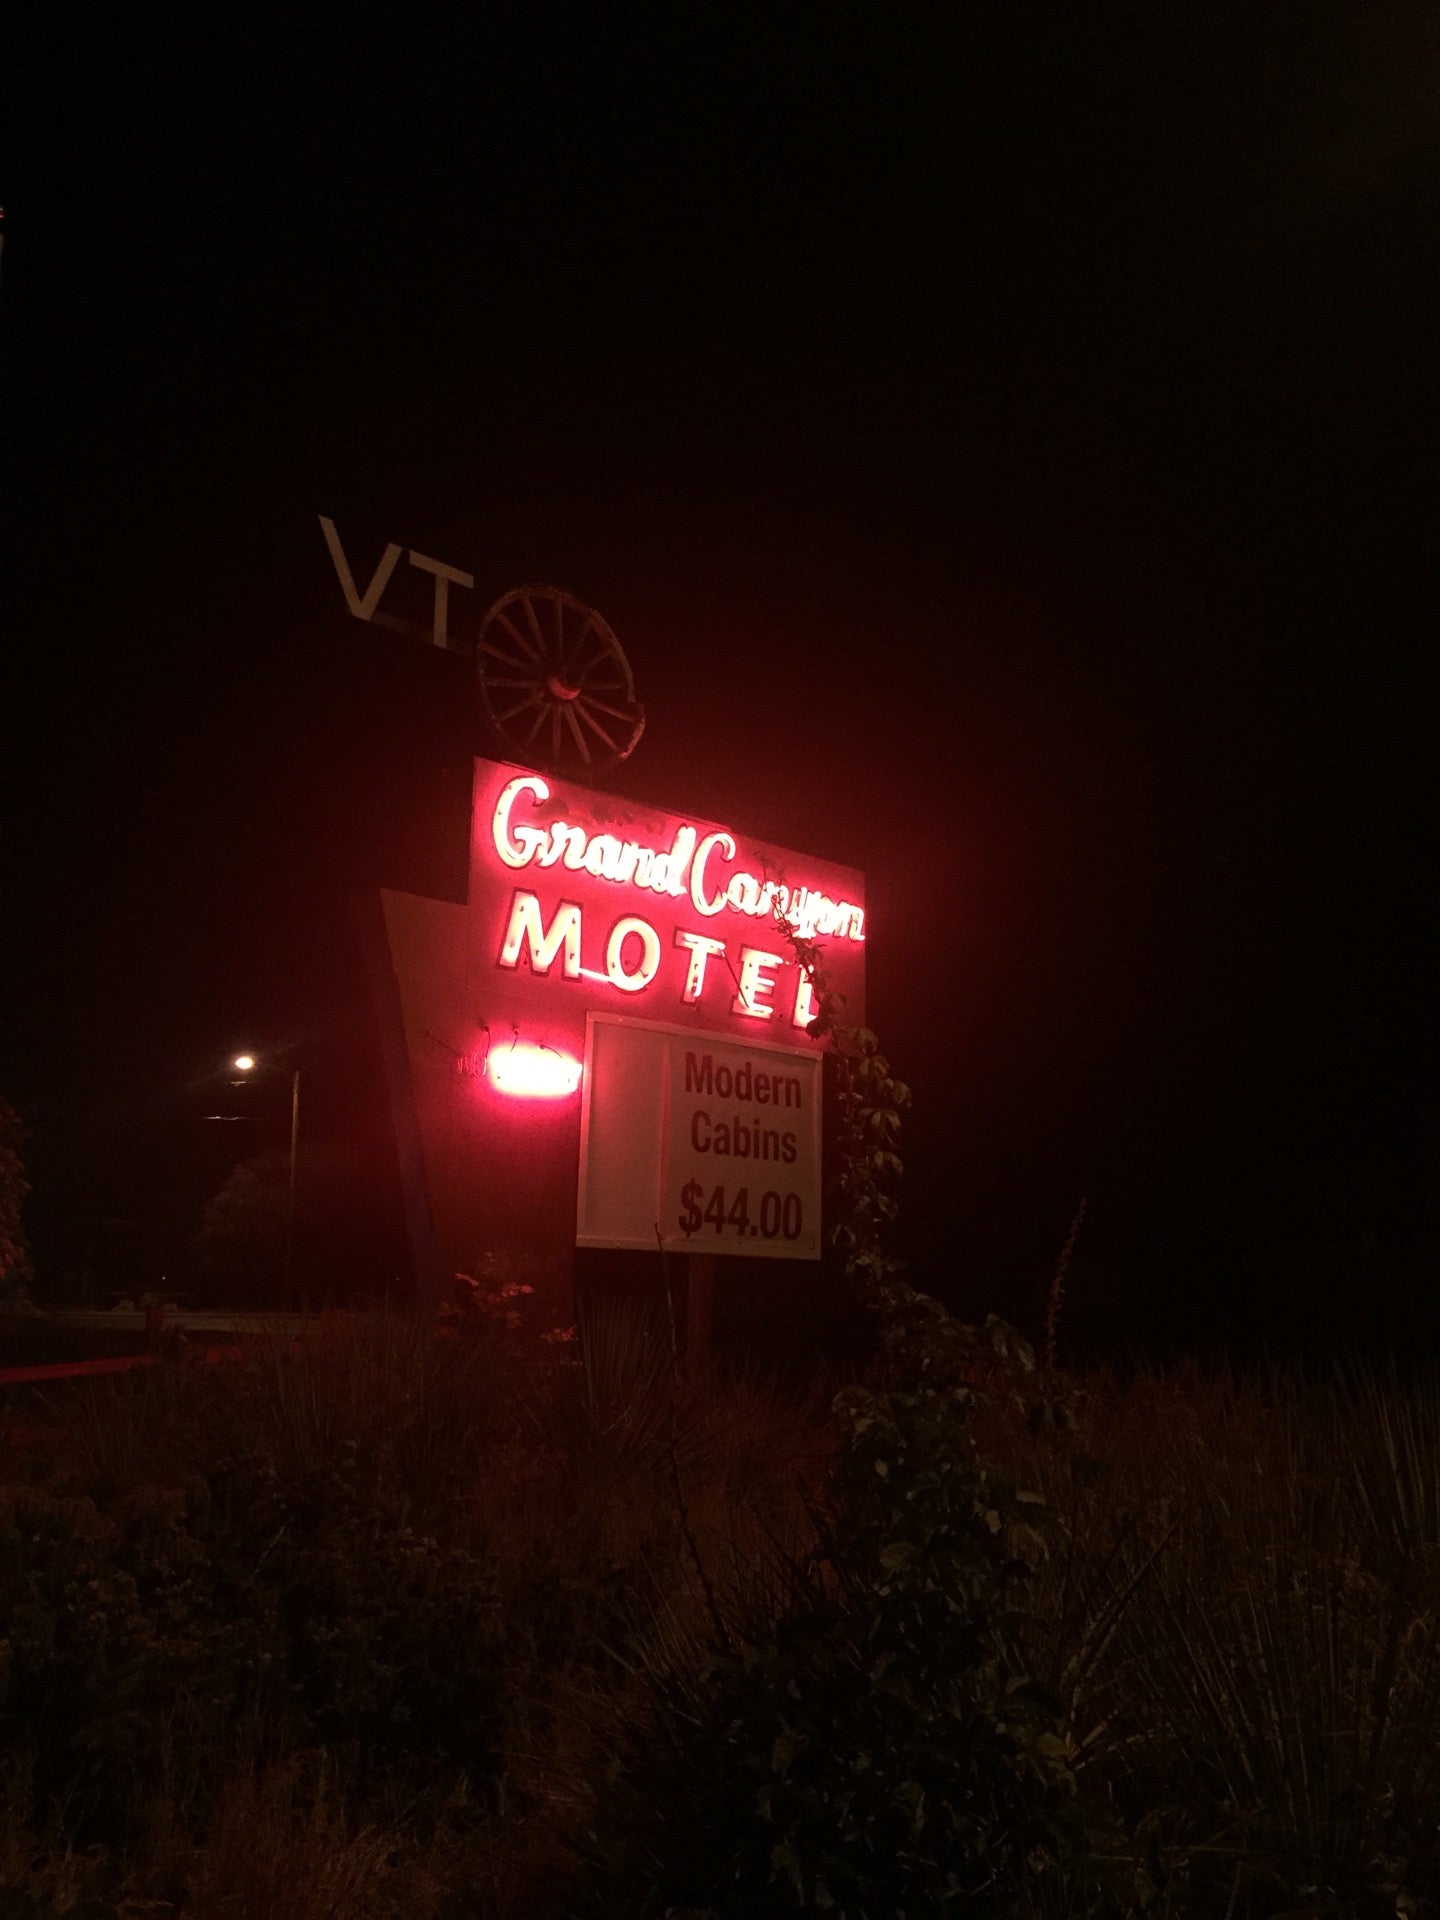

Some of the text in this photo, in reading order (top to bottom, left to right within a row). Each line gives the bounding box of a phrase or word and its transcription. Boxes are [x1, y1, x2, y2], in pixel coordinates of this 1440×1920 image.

[318, 515, 474, 649] VT
[493, 776, 866, 941] Grand Canyon
[499, 889, 820, 1030] MOTEL
[685, 1052, 801, 1108] Modern
[691, 1110, 797, 1164] Cabins
[678, 1178, 801, 1241] $44.00
